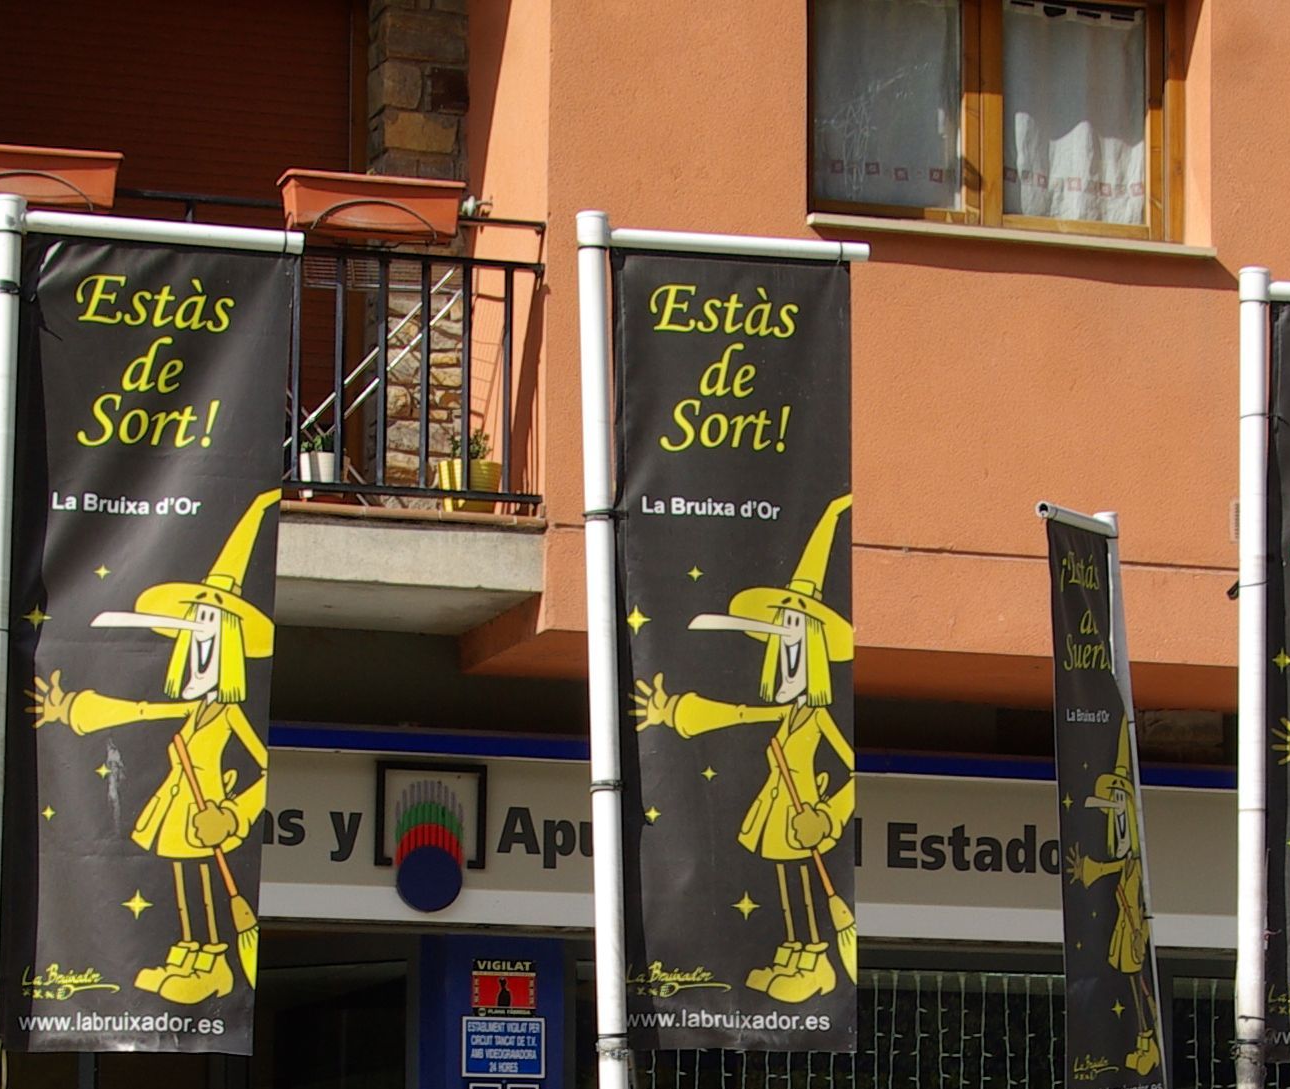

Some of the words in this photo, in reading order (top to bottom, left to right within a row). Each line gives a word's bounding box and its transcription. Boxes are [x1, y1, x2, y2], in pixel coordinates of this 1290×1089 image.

[75, 273, 235, 333] Estàs
[650, 283, 799, 338] Estàs
[121, 336, 184, 393] de
[699, 343, 756, 398] de
[76, 393, 220, 448] Sort!
[659, 399, 792, 452] Sort!
[51, 492, 77, 510] La
[83, 493, 150, 514] Bruixa
[156, 498, 201, 515] d'Or
[641, 496, 665, 514] La
[671, 497, 735, 517] Bruixa
[740, 501, 781, 520] d'Or
[330, 811, 362, 862] y
[477, 960, 532, 971] VIGILAT
[19, 1012, 225, 1034] www.labruixador.es
[627, 1009, 831, 1031] www.labruixador.es
